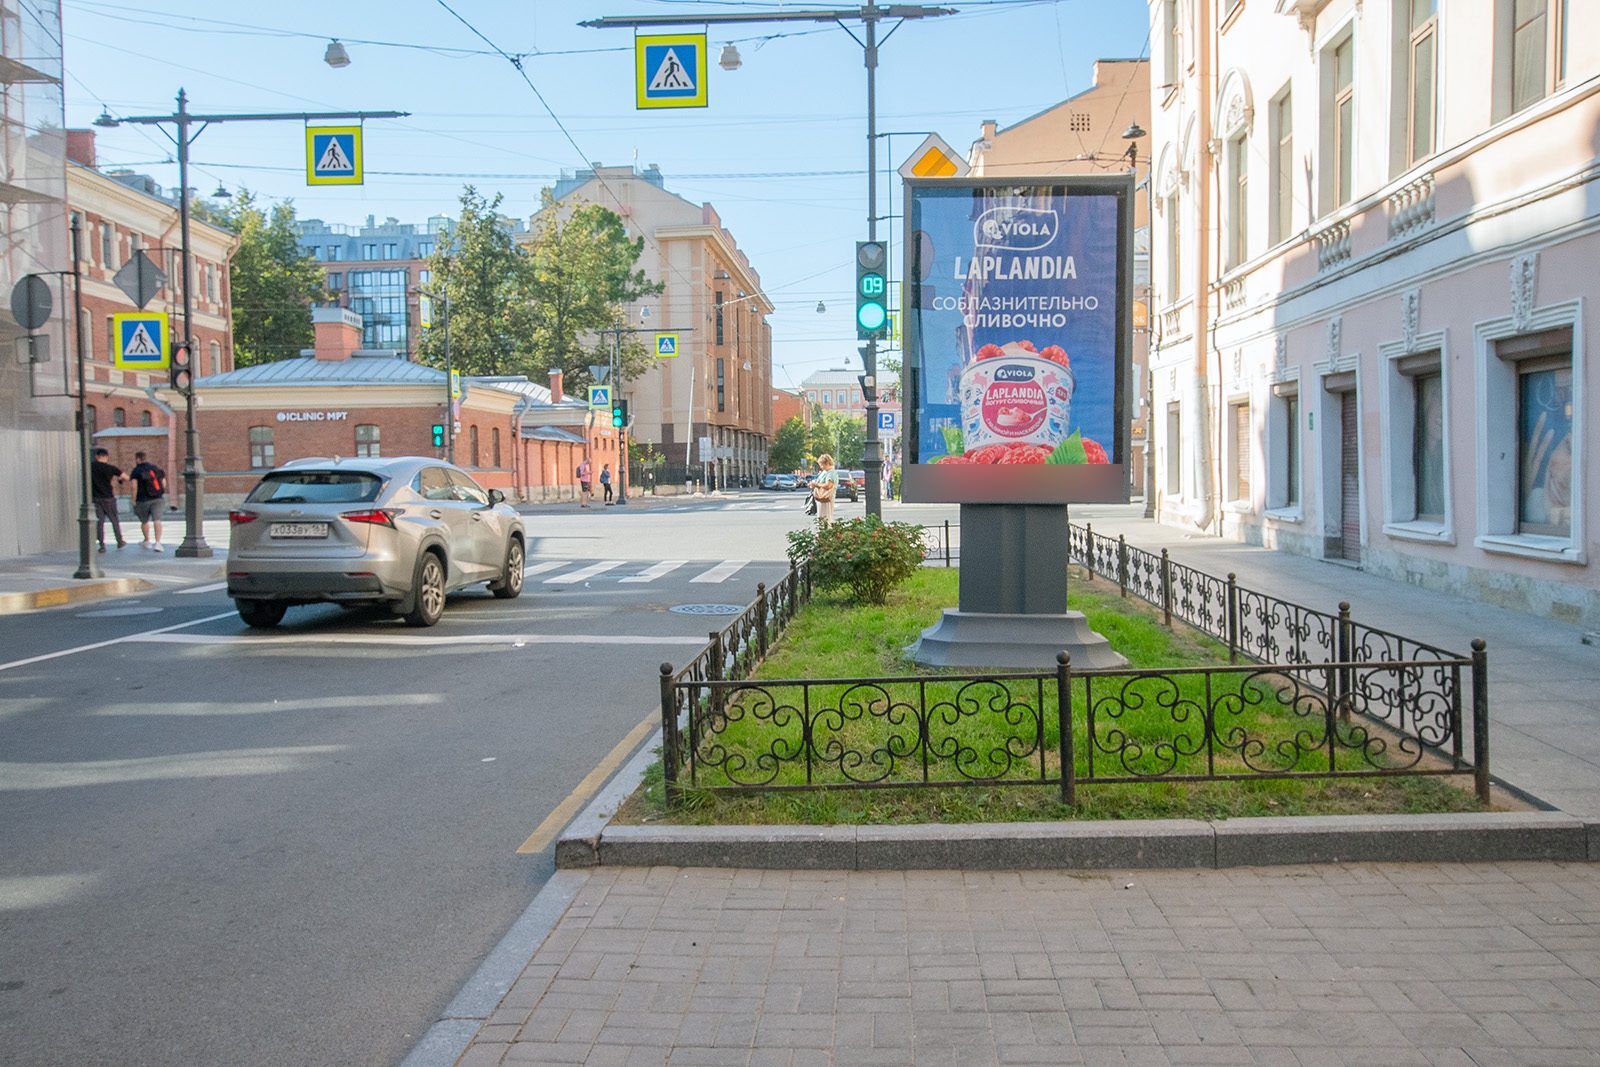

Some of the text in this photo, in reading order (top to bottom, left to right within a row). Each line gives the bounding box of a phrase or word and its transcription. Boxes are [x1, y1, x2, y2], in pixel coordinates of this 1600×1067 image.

[1002, 222, 1051, 237] VIOLA
[954, 255, 1077, 280] LAPLANDIA
[863, 277, 883, 294] 09
[932, 296, 1098, 312] СОБЛАЗНИТЕЛЬНО
[963, 313, 1066, 329] СЛИВОЧНО
[987, 387, 1043, 400] LAPLANDIA
